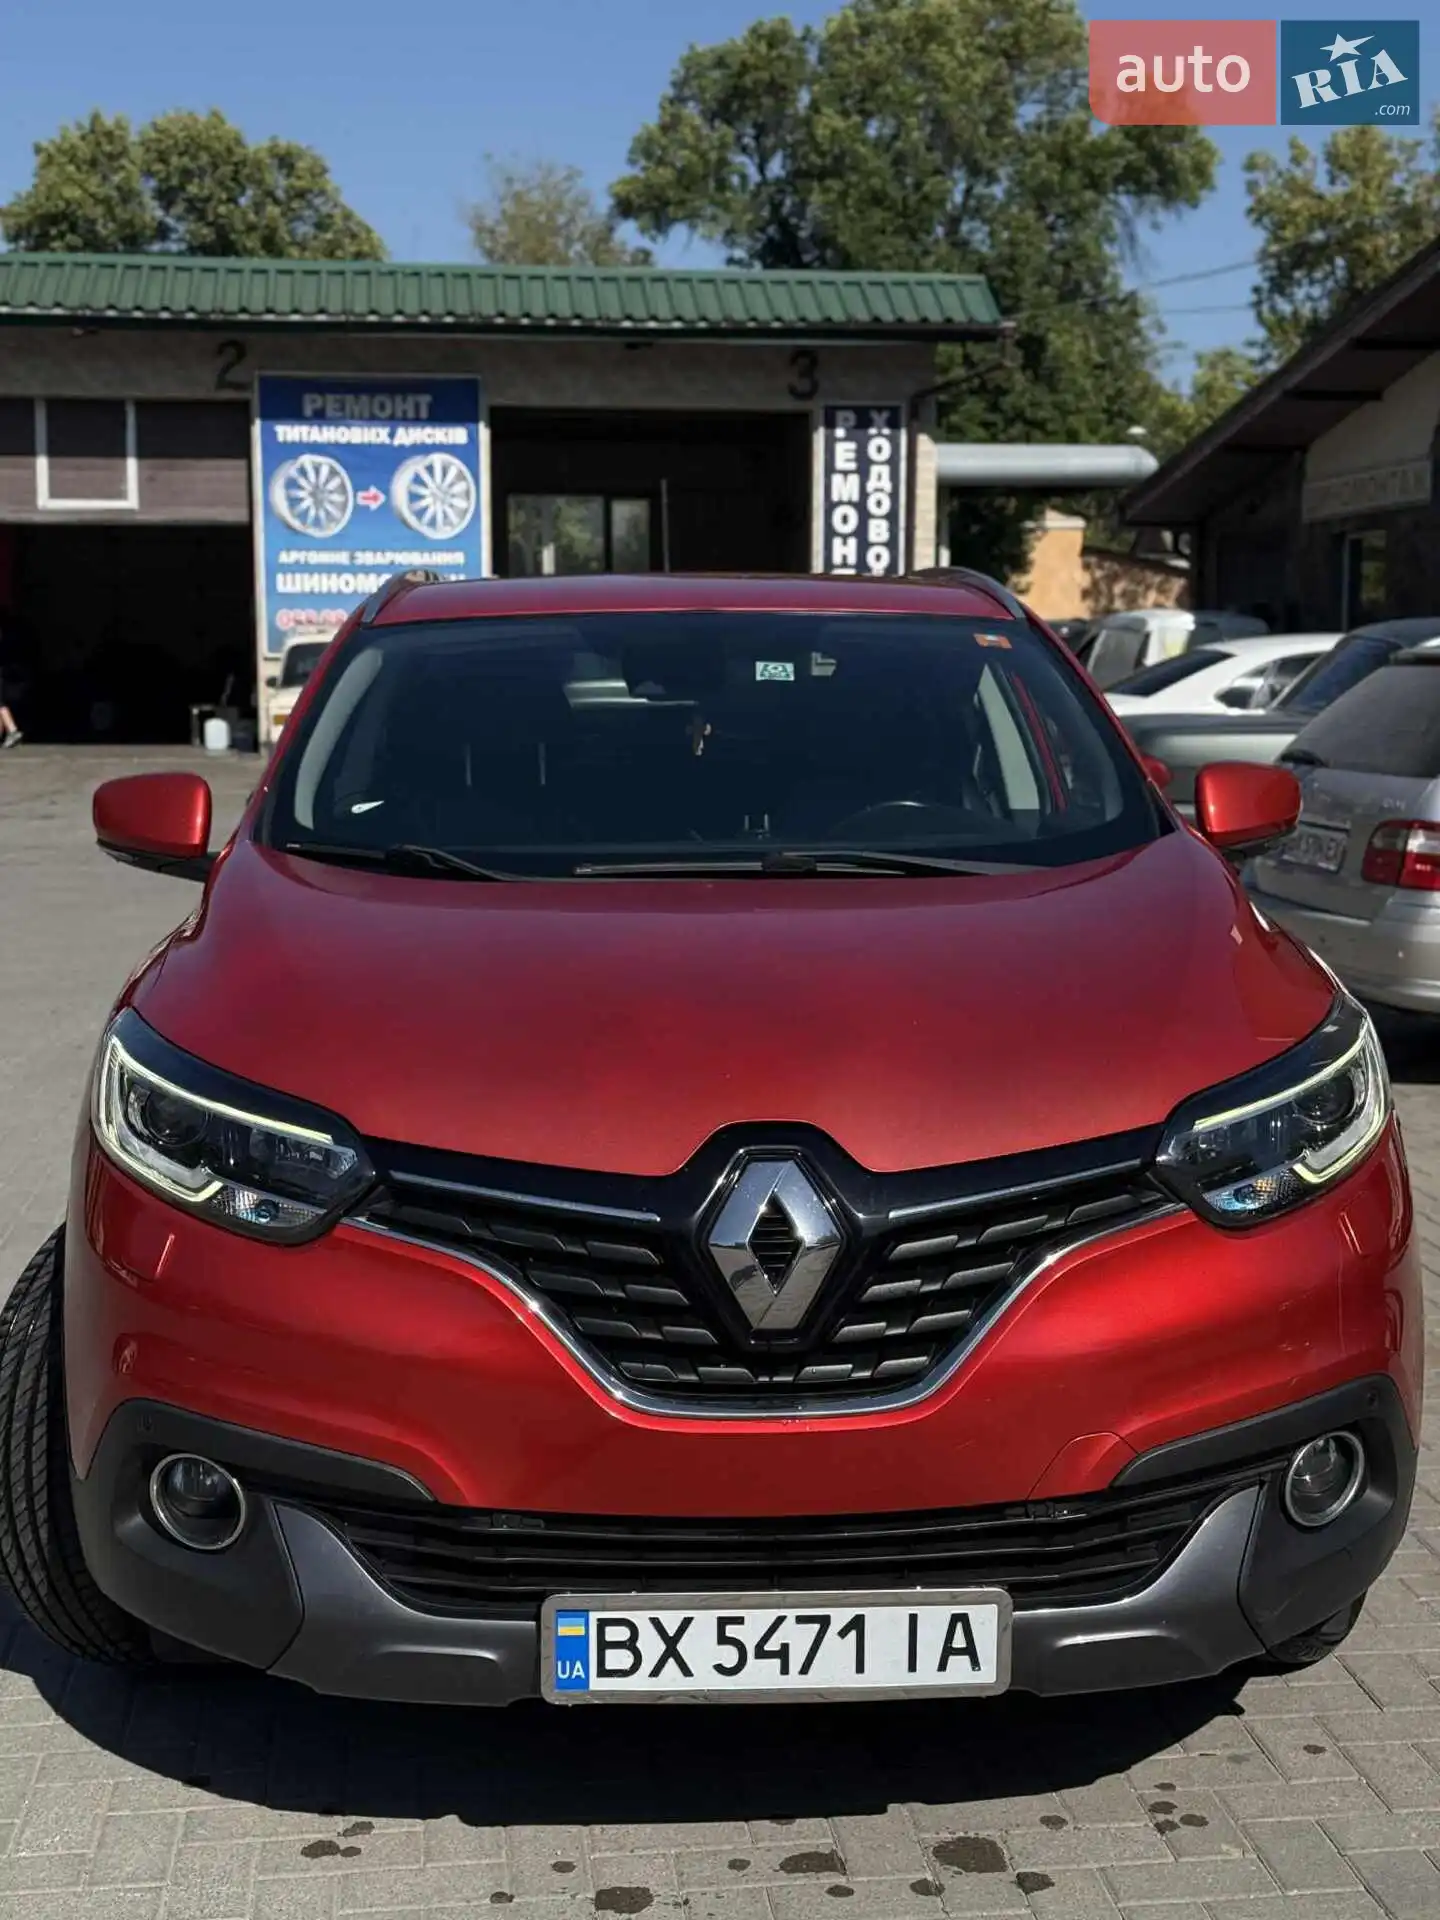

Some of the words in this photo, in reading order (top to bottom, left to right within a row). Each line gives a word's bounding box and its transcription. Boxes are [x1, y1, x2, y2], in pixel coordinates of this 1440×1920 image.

[215, 340, 251, 391] 2
[788, 348, 819, 400] 3
[304, 393, 433, 420] РЕМОНТ
[274, 425, 390, 445] ТИТАНОВИХ
[393, 427, 468, 447] ДИСКІВ
[831, 409, 860, 576] РЕМОН
[866, 409, 892, 576] ХОДОВО
[557, 1661, 585, 1679] UA
[596, 1617, 694, 1678] BX
[712, 1614, 865, 1676] 5471
[908, 1612, 982, 1673] IA
